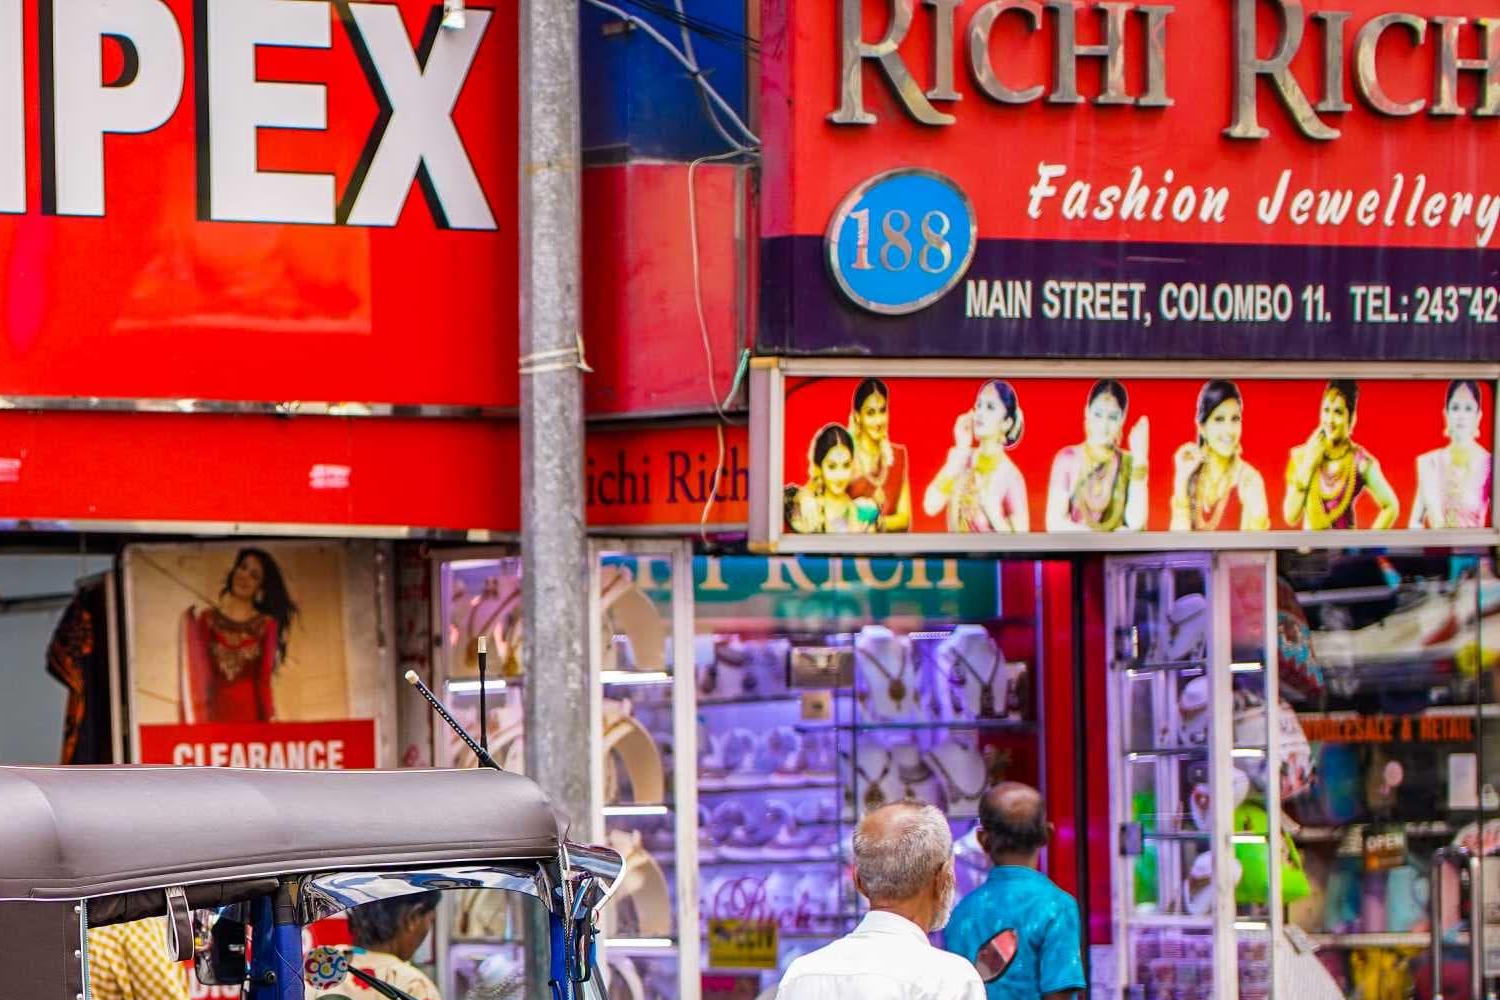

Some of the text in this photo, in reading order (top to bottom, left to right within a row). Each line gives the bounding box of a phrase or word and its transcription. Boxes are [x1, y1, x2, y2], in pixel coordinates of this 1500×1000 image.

[826, 0, 1500, 140] RICHI RICH
[1027, 160, 1500, 248] Fashion Jewellery
[850, 207, 952, 275] 188
[964, 279, 1033, 319] MAIN
[1042, 280, 1152, 327] STREET,
[1159, 281, 1294, 323] COLOMBO
[1301, 284, 1333, 323] 11.
[666, 447, 749, 504] Rich
[172, 738, 345, 769] CLEARANCE
[1420, 714, 1473, 742] RETAIL
